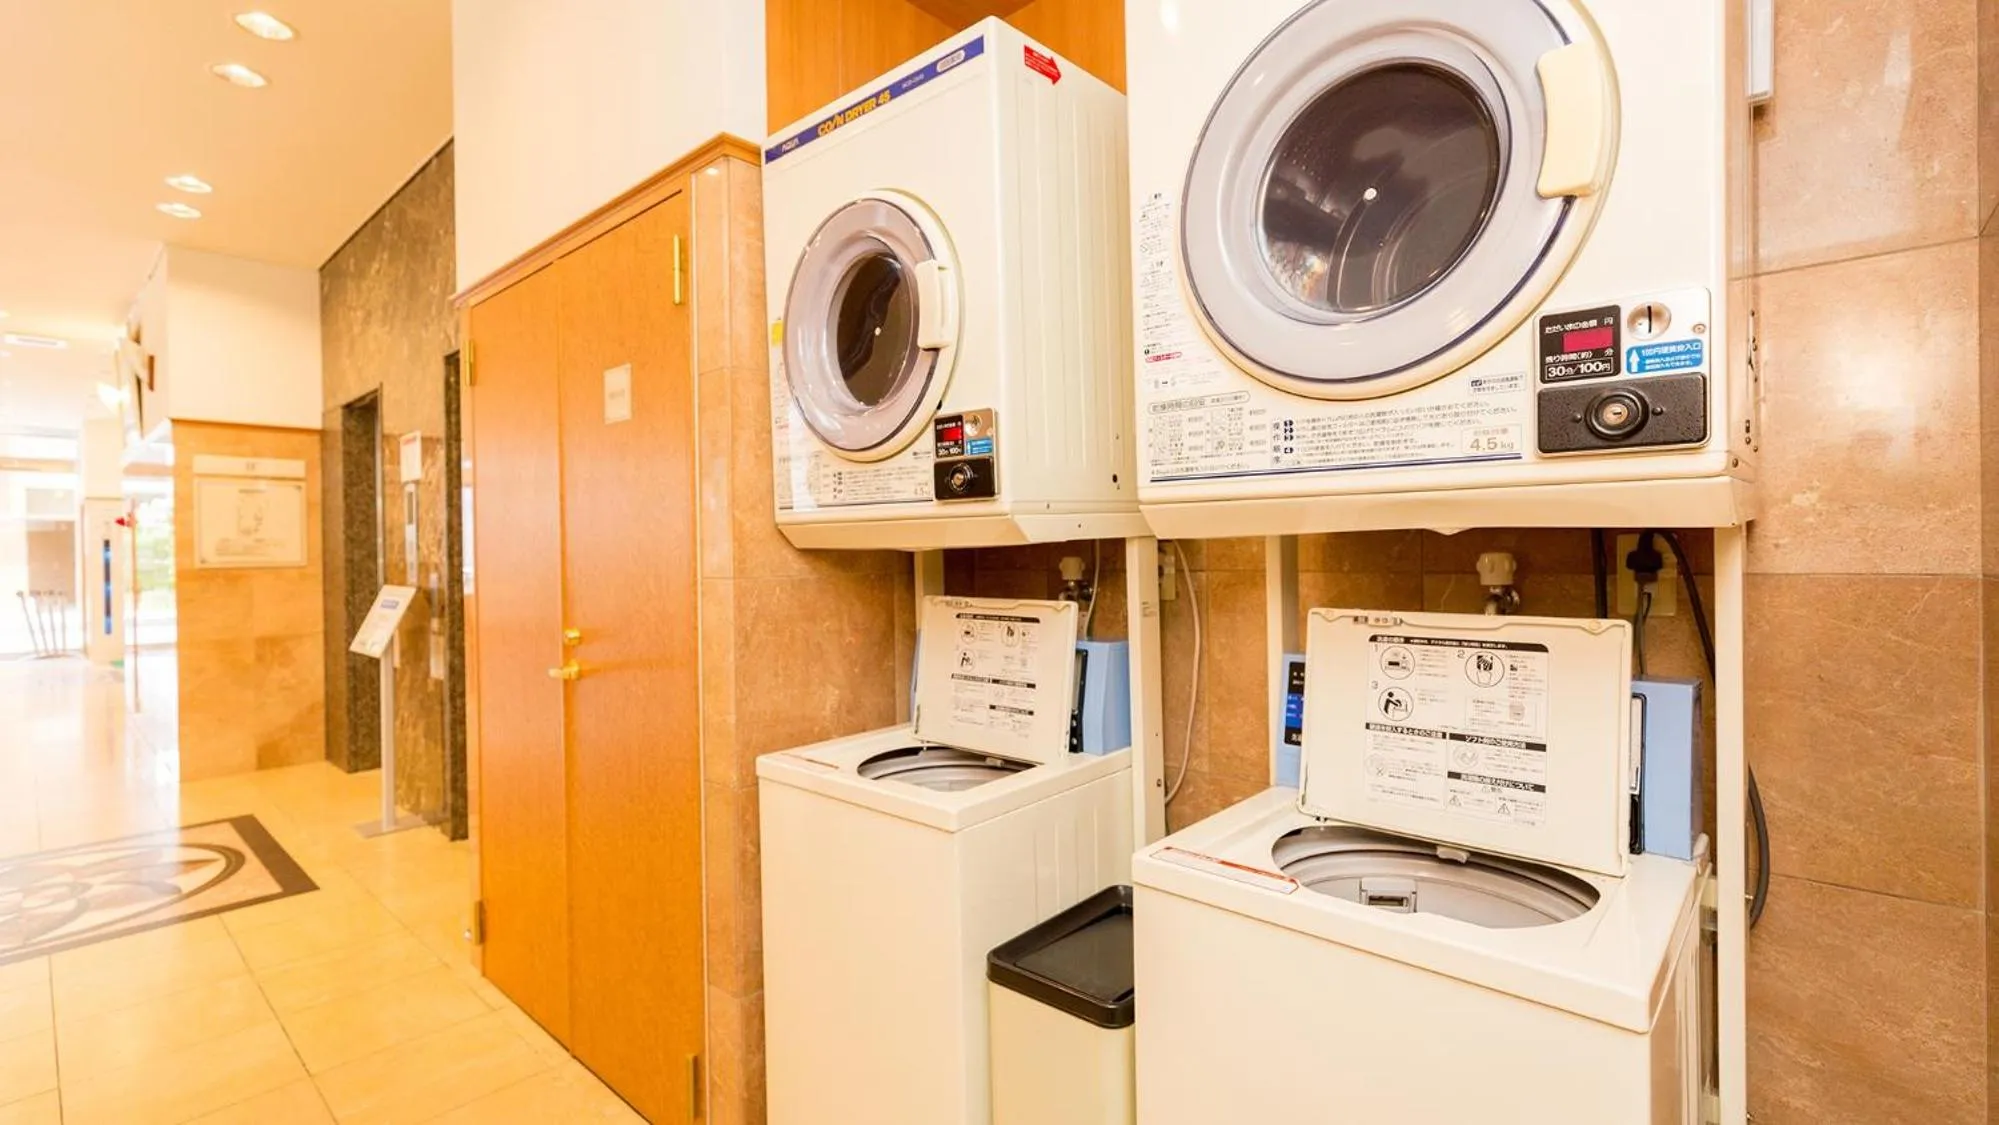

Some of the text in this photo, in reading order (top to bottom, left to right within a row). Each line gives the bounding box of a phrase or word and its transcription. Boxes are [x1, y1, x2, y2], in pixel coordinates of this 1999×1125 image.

[845, 97, 877, 122] DRYER
[1604, 316, 1614, 325] 円
[1469, 436, 1498, 452] 4.5
